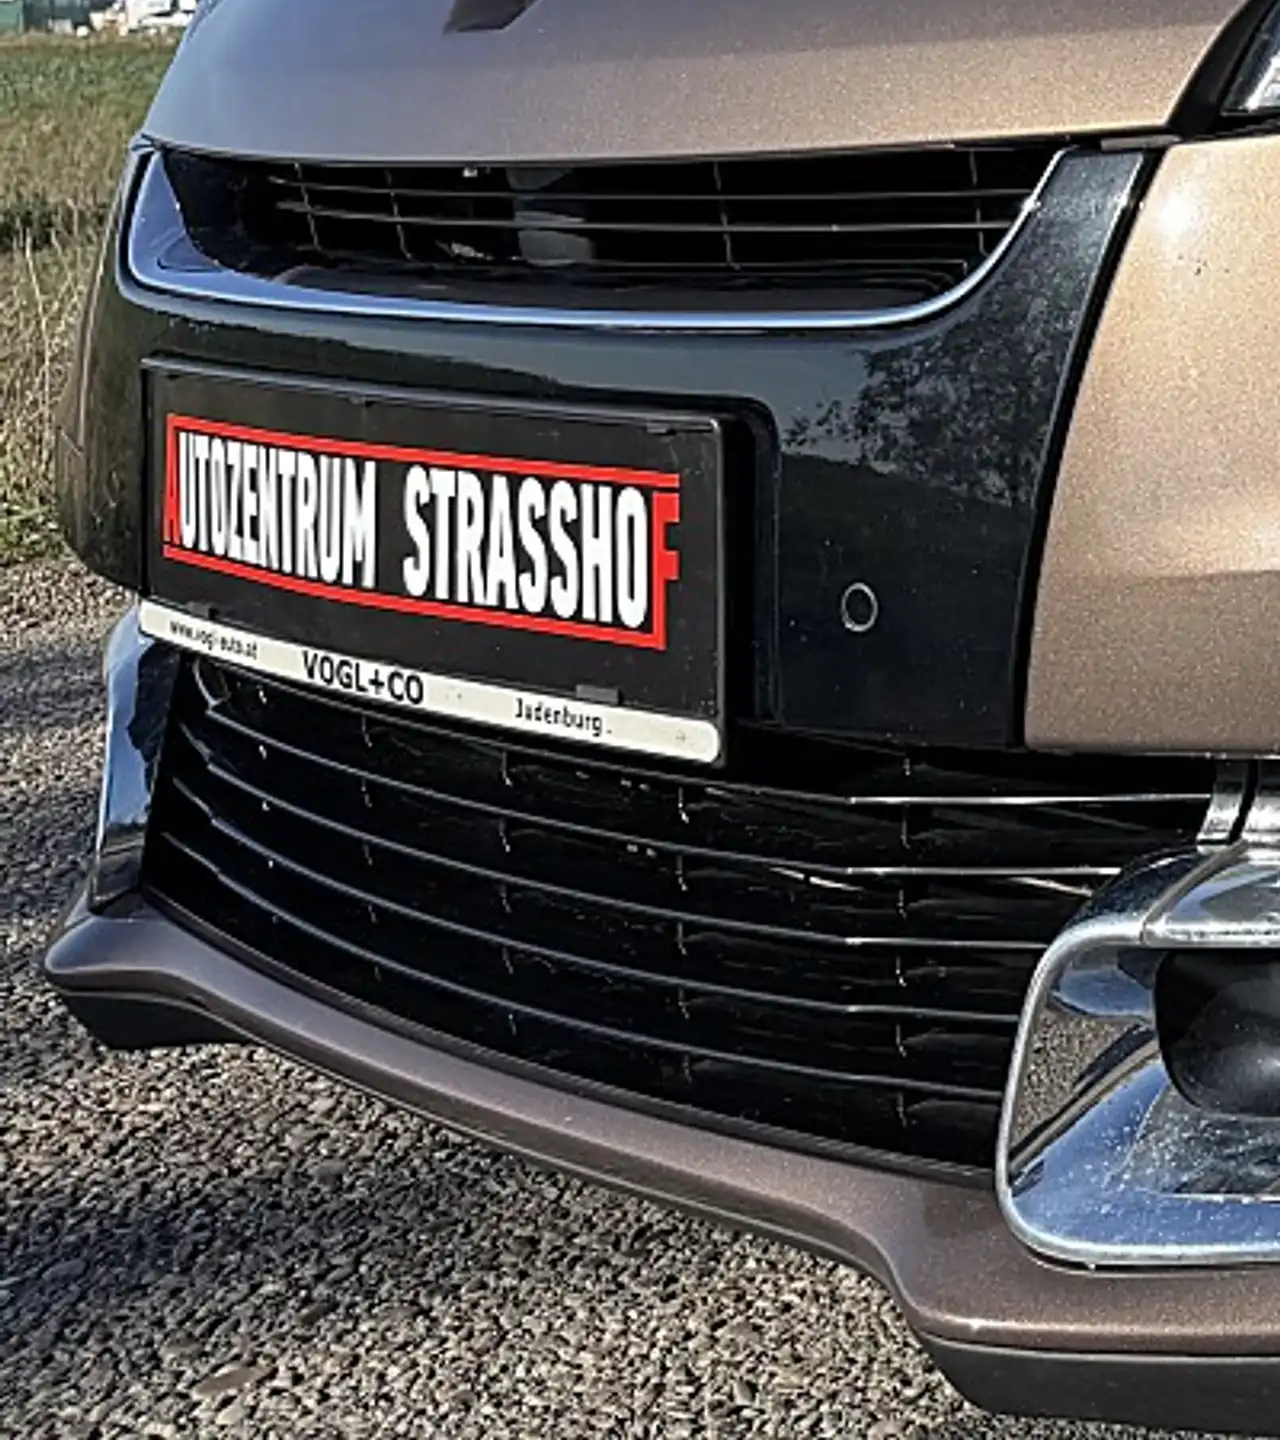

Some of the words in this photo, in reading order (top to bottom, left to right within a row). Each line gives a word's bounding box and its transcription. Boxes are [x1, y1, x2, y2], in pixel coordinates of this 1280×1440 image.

[162, 413, 377, 590] AUTOZENTRUM
[402, 463, 681, 651] STRASSHOF
[302, 649, 424, 705] VOGL+CO
[514, 697, 603, 738] Judenburg
